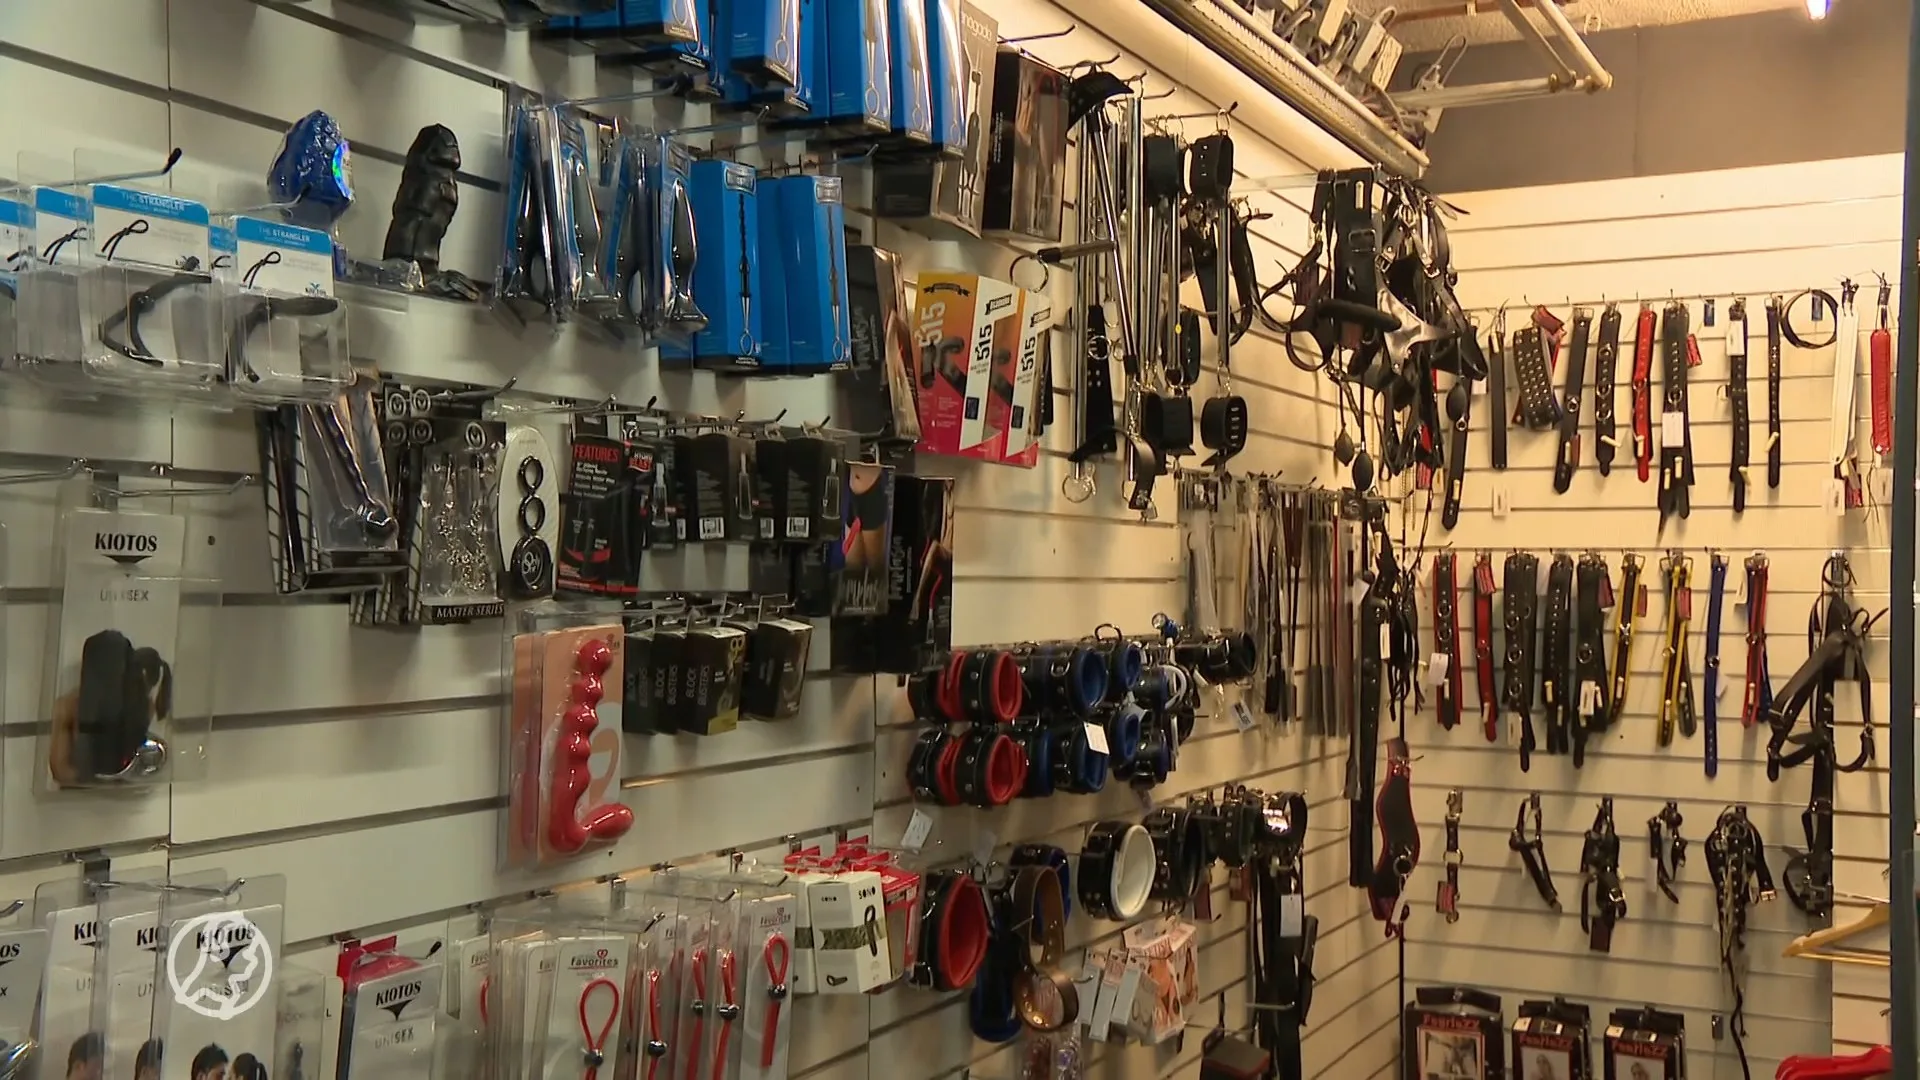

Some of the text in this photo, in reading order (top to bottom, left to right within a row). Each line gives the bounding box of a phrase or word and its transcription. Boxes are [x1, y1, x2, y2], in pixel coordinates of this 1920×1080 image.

[272, 228, 311, 242] STRANGLER
[575, 444, 619, 462] FEATURES
[95, 533, 157, 551] KIOTOS
[437, 602, 473, 618] MASTER
[570, 955, 618, 967] favorites
[375, 980, 422, 1006] KIOTOS
[374, 1026, 414, 1049] UNISEX
